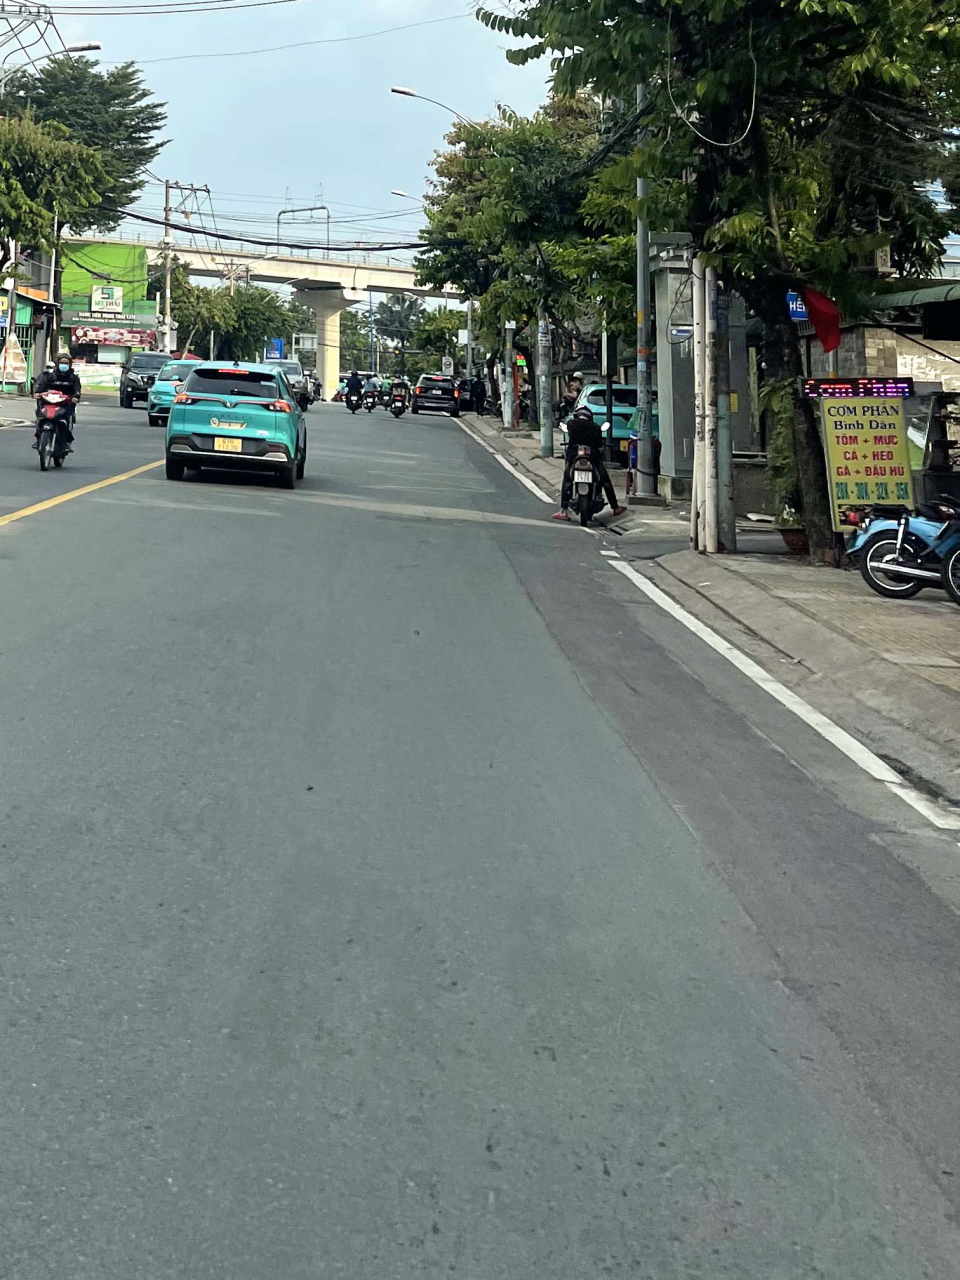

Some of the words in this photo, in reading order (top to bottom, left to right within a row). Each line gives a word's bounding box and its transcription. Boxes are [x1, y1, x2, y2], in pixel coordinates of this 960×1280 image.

[828, 405, 857, 417] CƠM
[869, 419, 896, 430] Dân
[873, 451, 893, 460] HEO
[837, 465, 851, 476] GÀ
[865, 464, 886, 478] ĐẬU
